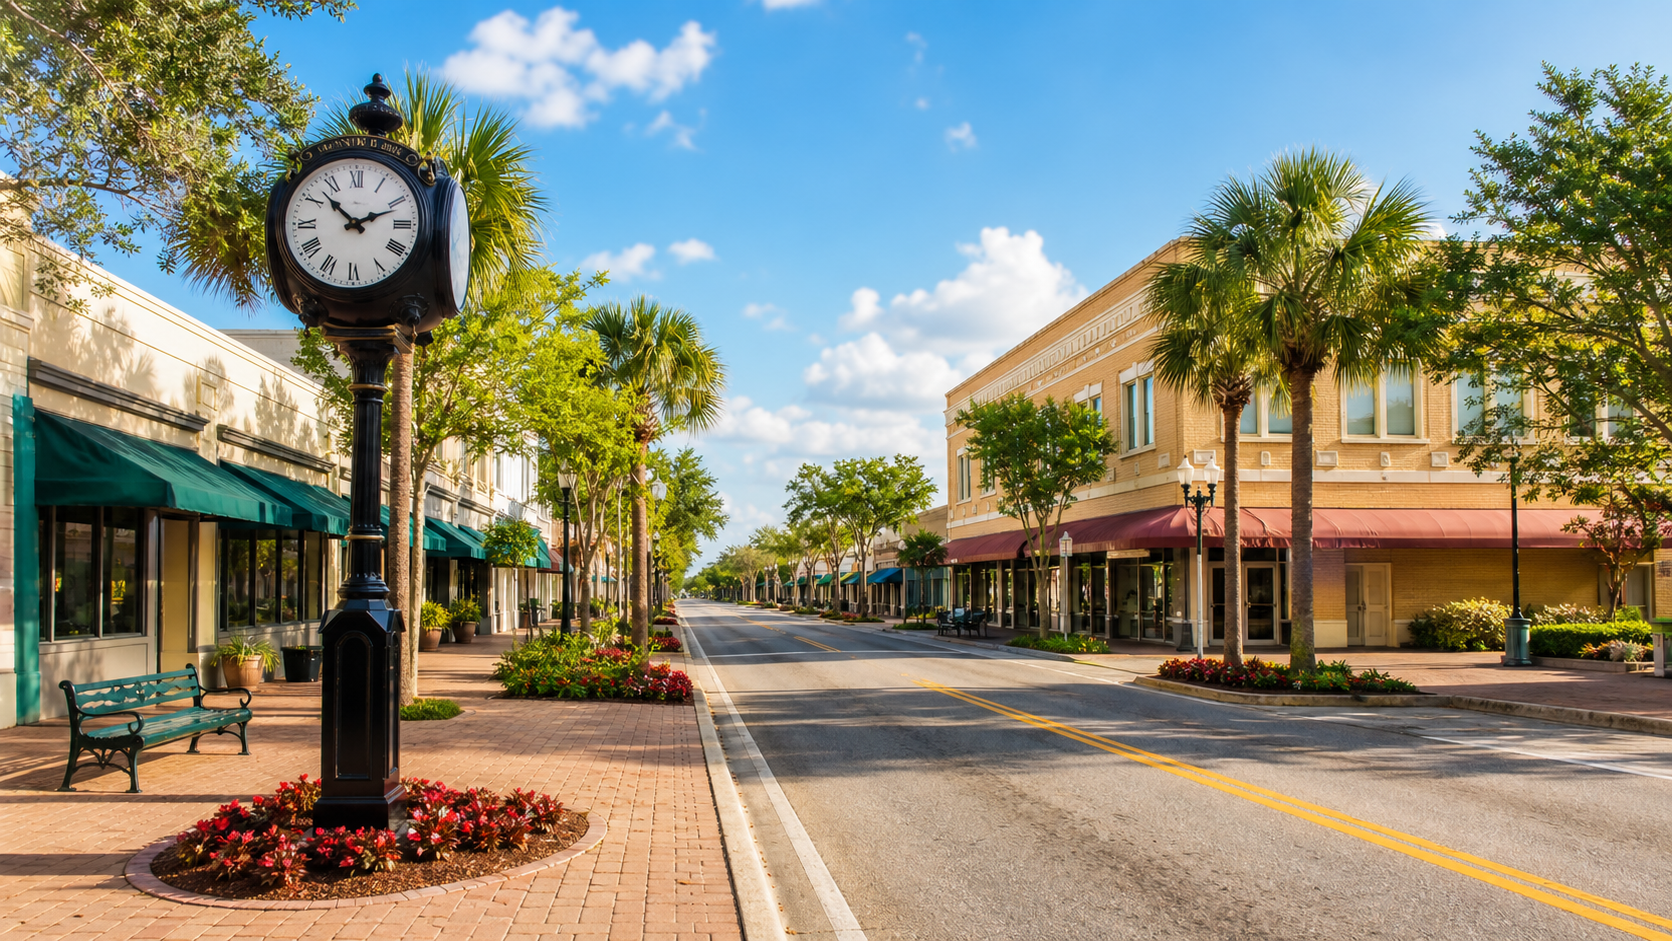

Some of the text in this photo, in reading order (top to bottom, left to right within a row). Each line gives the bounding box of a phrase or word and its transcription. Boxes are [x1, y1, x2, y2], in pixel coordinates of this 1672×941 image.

[324, 175, 341, 196] XI
[349, 170, 364, 189] XII
[305, 193, 324, 209] X
[387, 195, 406, 209] II
[393, 219, 412, 230] III
